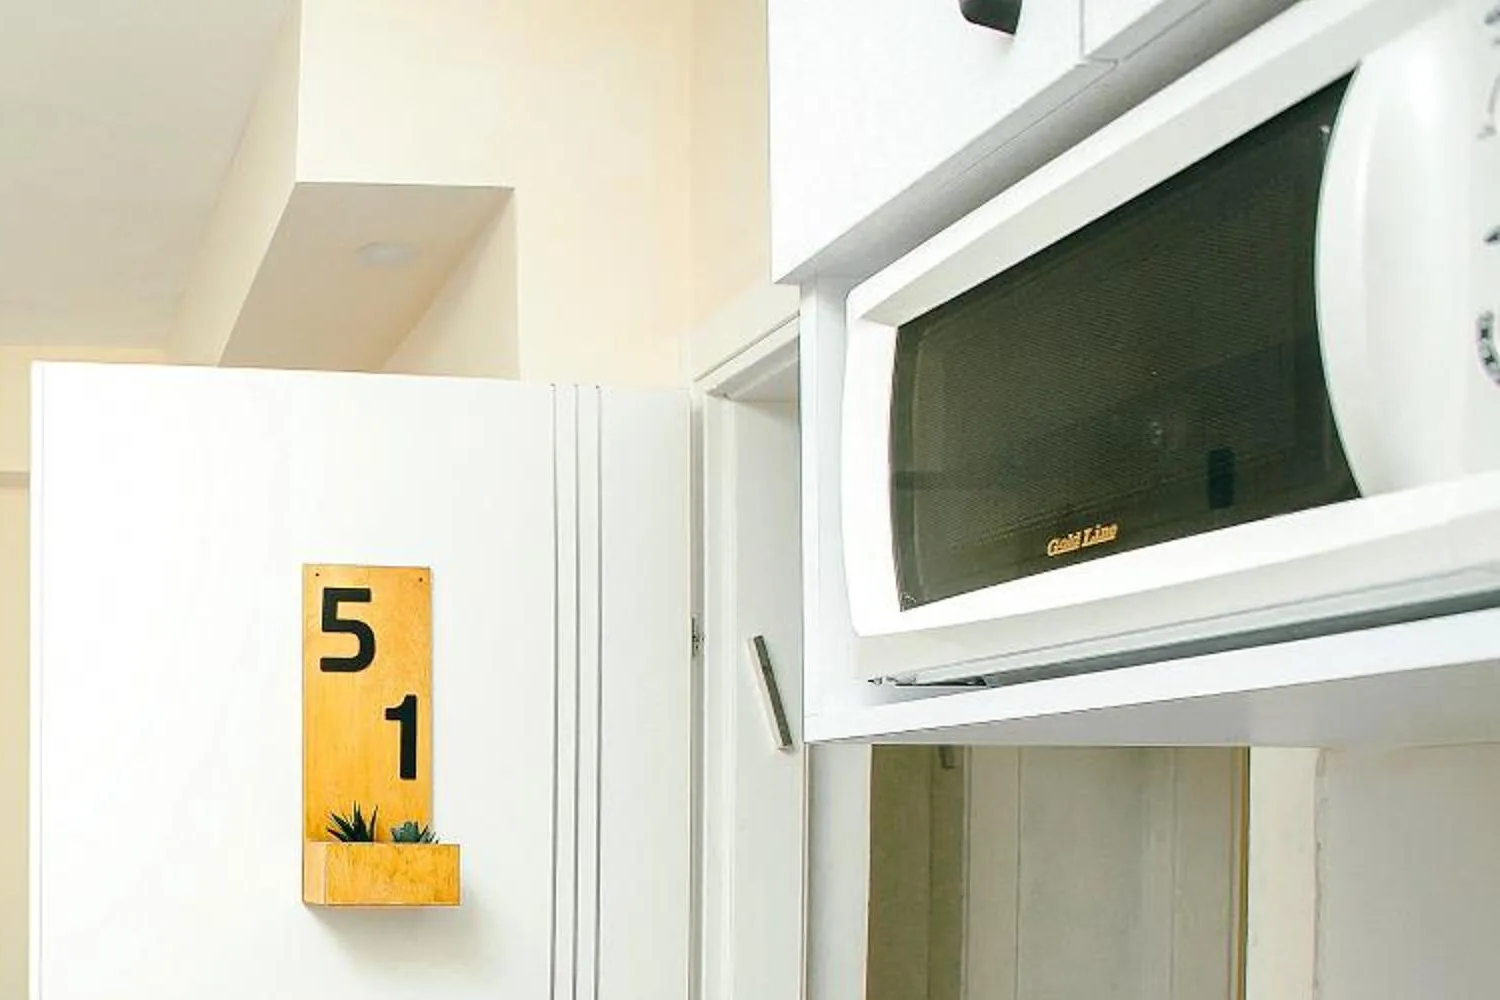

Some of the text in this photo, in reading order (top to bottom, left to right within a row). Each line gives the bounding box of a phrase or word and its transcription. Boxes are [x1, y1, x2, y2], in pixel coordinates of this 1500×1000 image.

[1047, 523, 1118, 556] Gold Line
[319, 587, 375, 672] 5
[385, 694, 419, 780] 1
